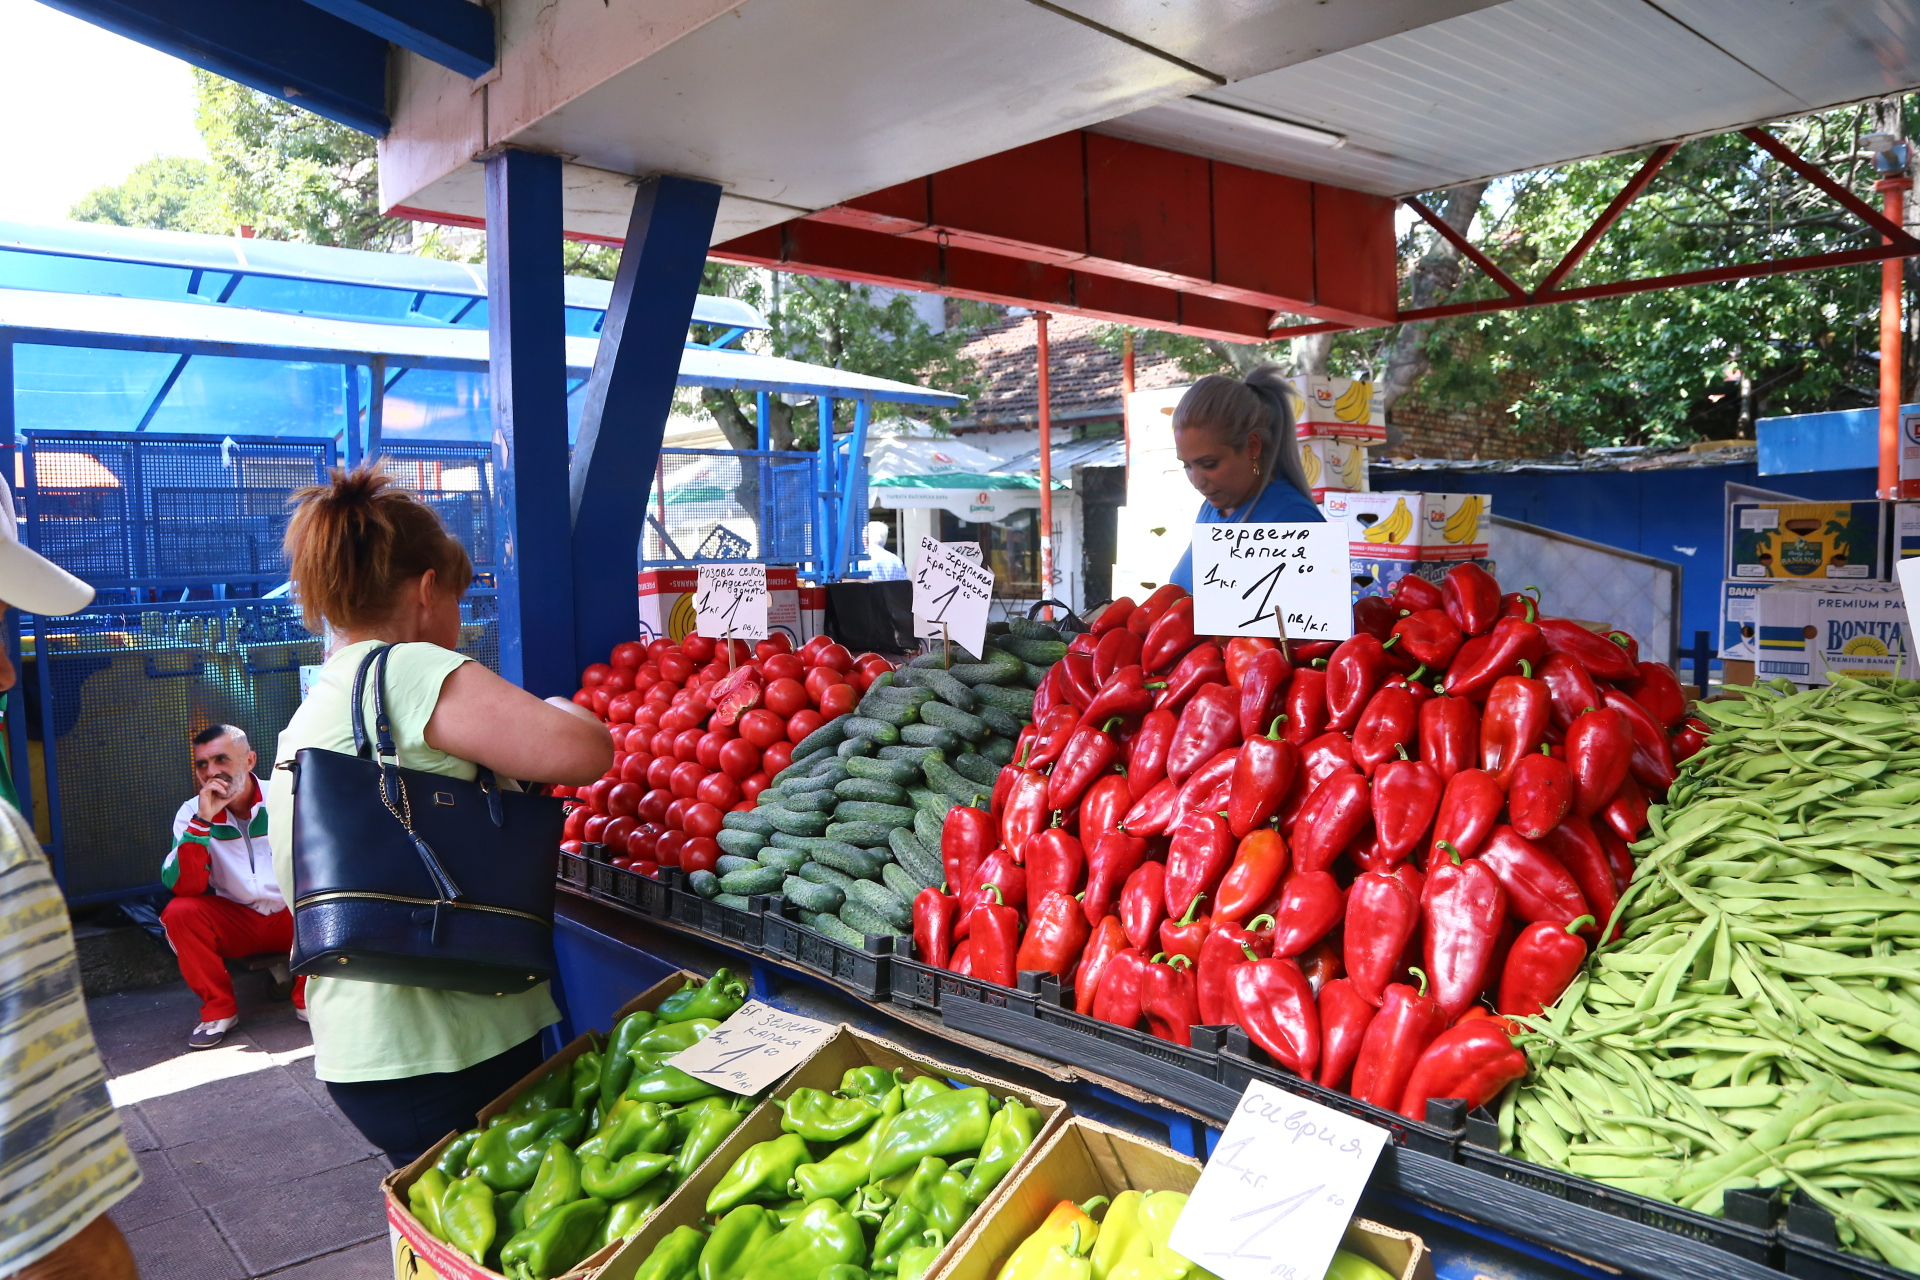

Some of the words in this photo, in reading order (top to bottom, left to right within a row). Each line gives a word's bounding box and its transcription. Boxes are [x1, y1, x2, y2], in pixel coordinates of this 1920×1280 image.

[1317, 389, 1332, 400] Dole
[1330, 500, 1347, 510] Dole
[1431, 510, 1445, 521] Dole
[917, 568, 928, 584] 1
[1203, 563, 1221, 585] 1
[699, 591, 711, 615] 1
[927, 584, 960, 625] 1
[1238, 562, 1286, 628] 1
[1298, 565, 1314, 574] 60
[1818, 599, 1879, 609] PREMIUM
[721, 592, 743, 637] 1
[1827, 620, 1908, 652] BONITA
[1826, 656, 1865, 664] PREMIUM
[709, 1029, 732, 1041] 1
[691, 1043, 767, 1074] 1
[763, 1048, 779, 1056] 60
[1215, 1136, 1255, 1172] 1
[1203, 1184, 1326, 1260] 1
[1326, 1193, 1345, 1206] 60
